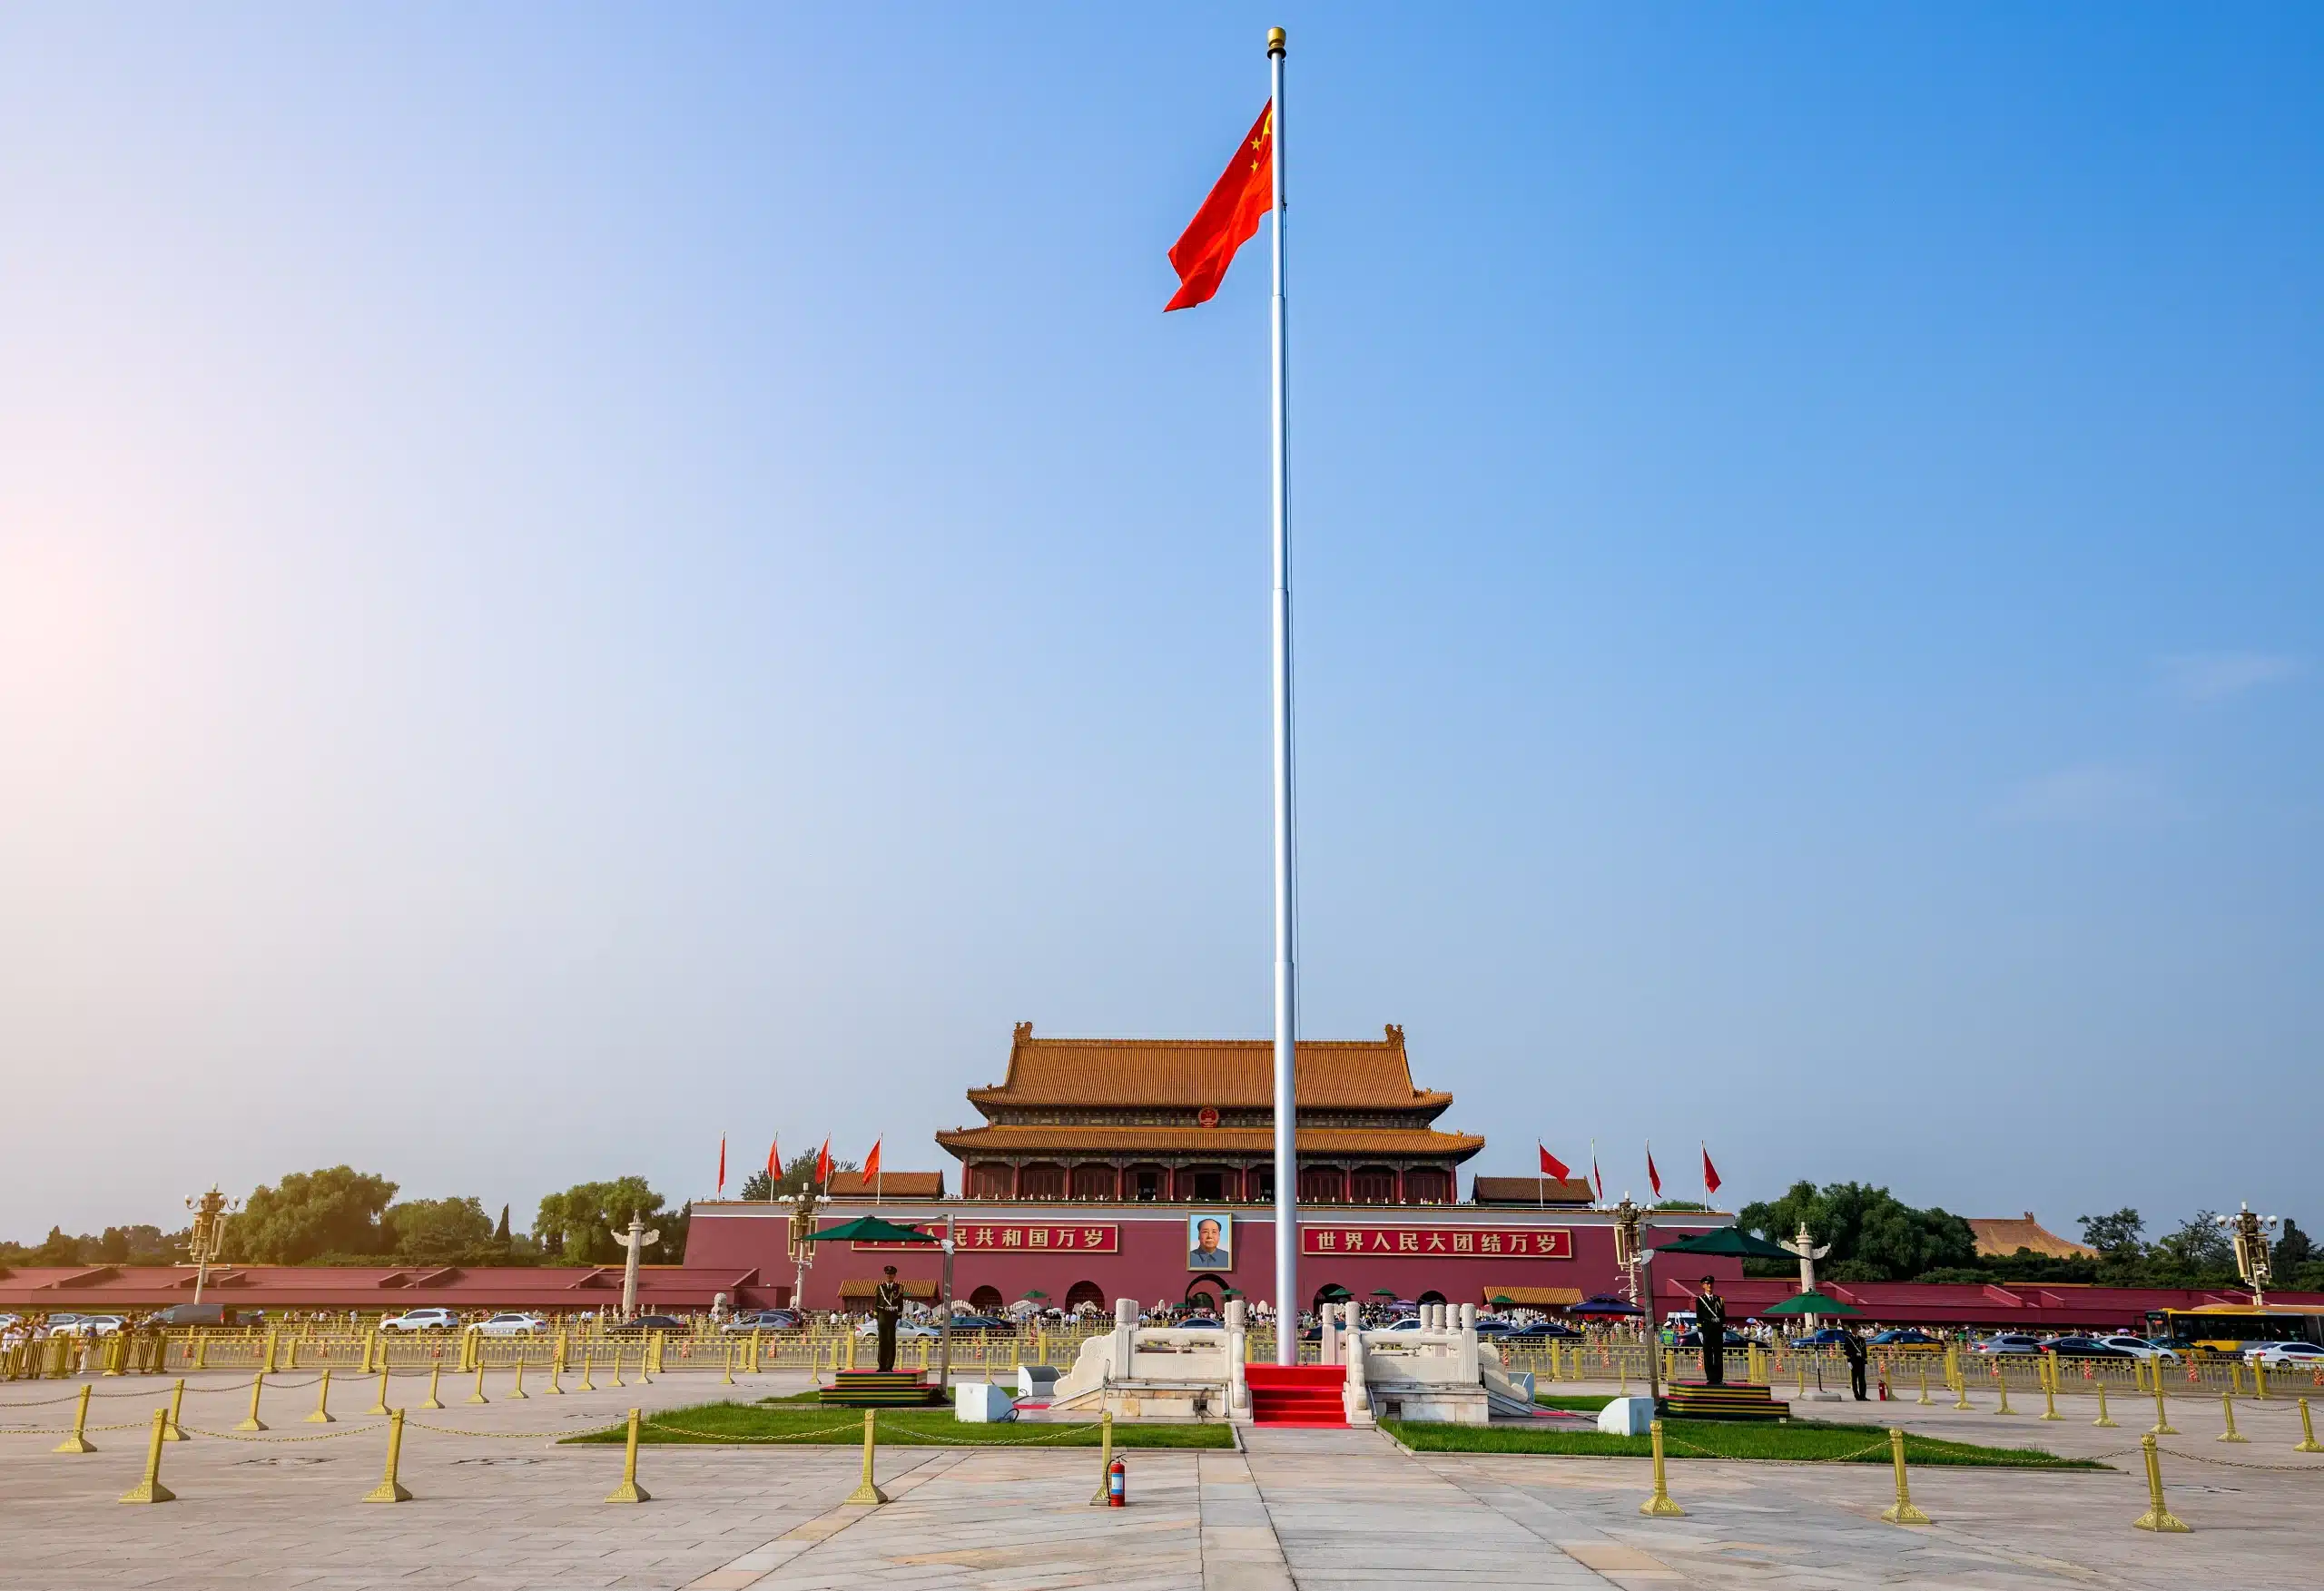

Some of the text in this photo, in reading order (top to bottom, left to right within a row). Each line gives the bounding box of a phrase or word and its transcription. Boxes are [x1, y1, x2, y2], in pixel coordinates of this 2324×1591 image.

[1316, 1232, 1557, 1253] 世界人民大团结万岁
